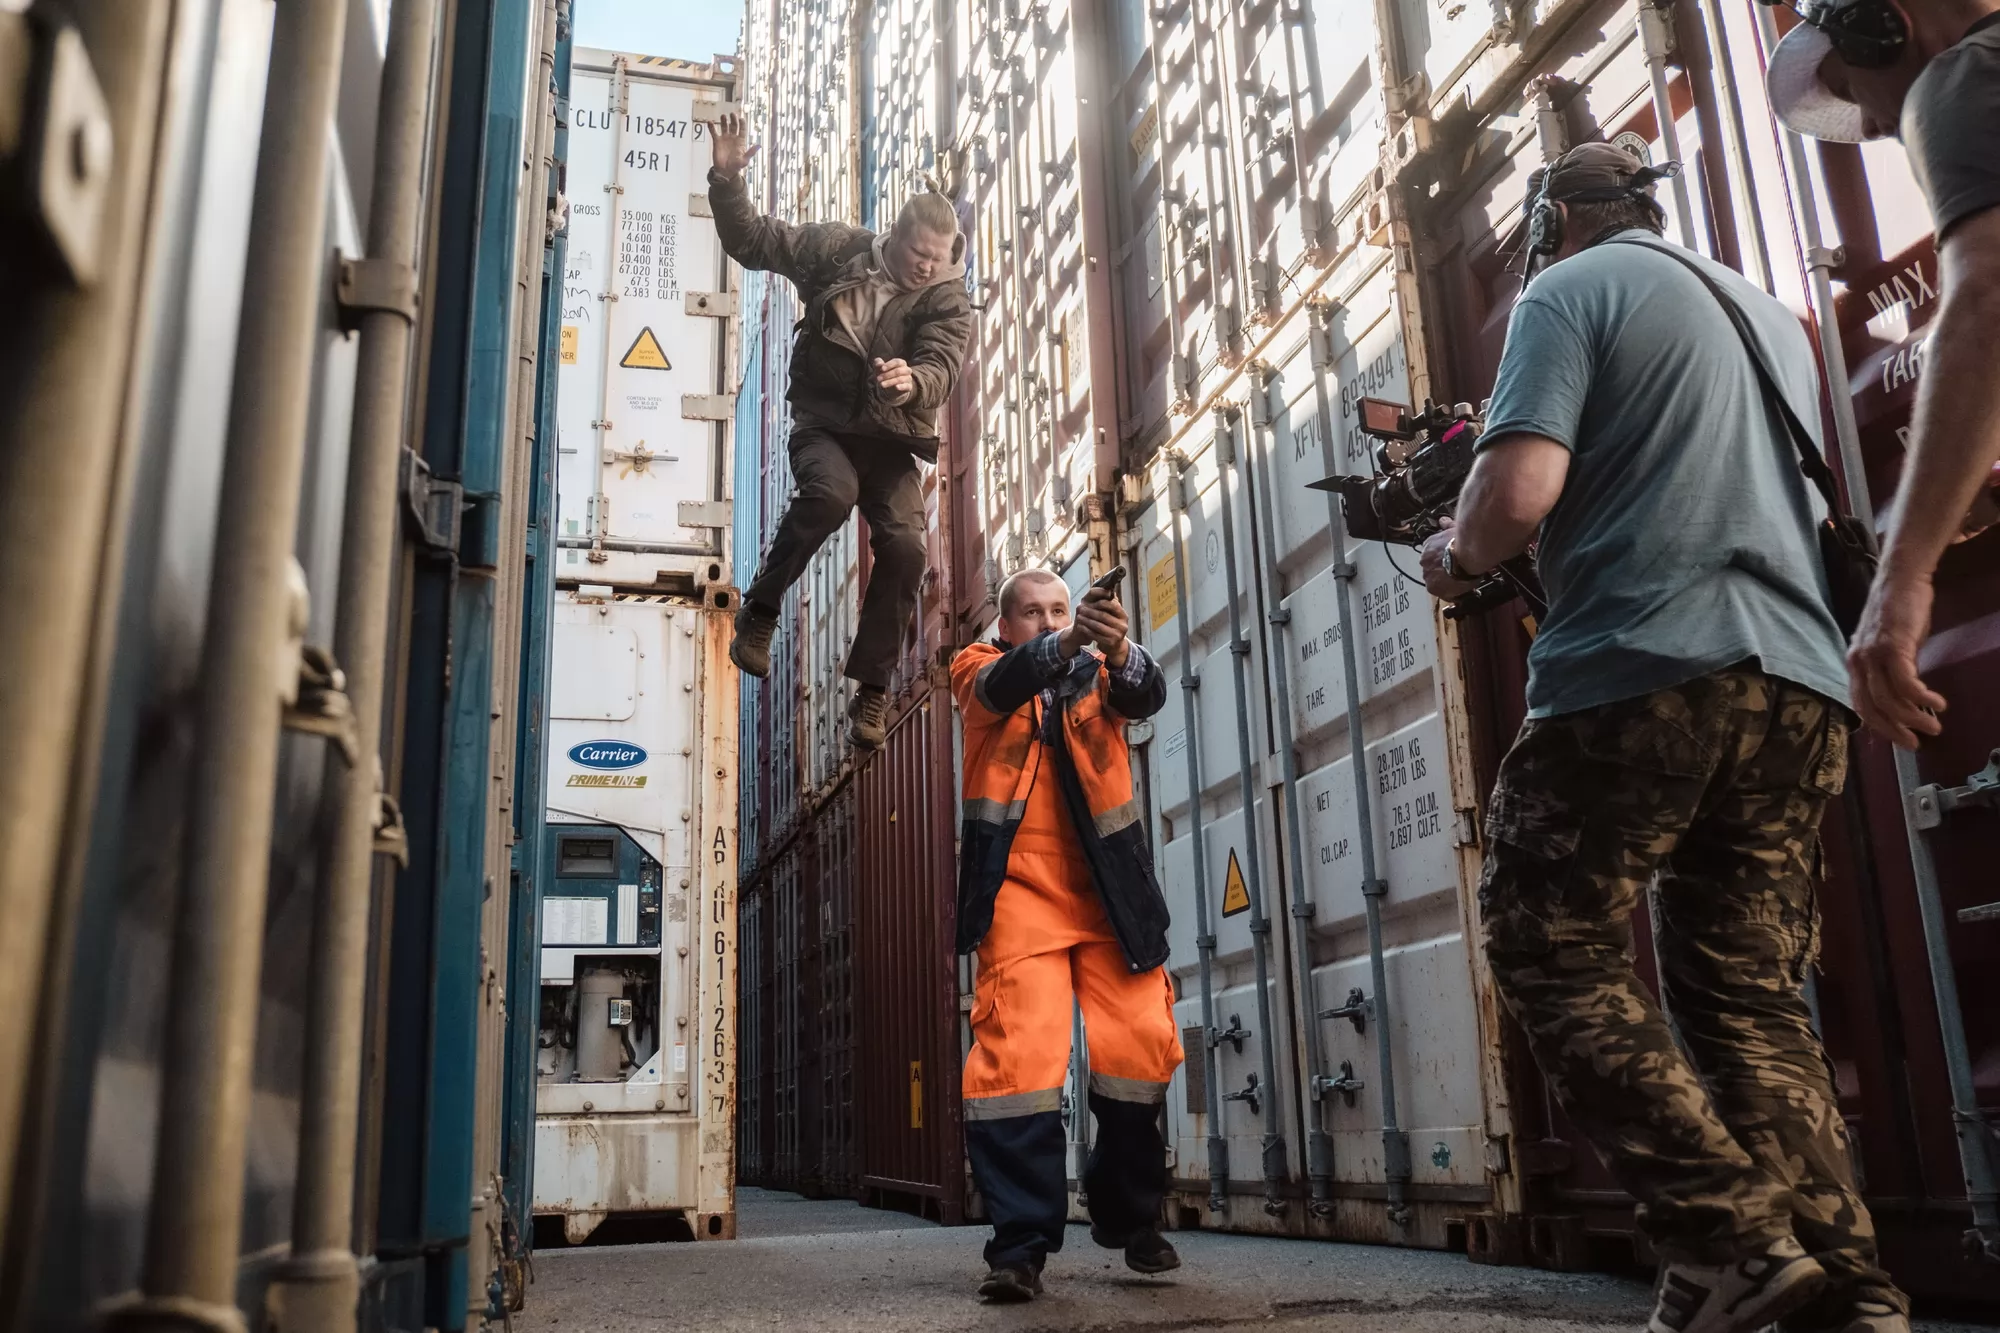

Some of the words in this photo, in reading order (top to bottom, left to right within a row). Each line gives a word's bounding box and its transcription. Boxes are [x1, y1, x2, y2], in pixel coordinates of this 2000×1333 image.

[570, 108, 611, 130] CLU
[625, 115, 687, 139] 118547
[694, 123, 703, 140] 9
[624, 150, 670, 172] 45R1
[573, 204, 601, 216] GROSS
[621, 210, 653, 222] 35.000
[621, 221, 653, 233] 77.160
[626, 232, 652, 244] 4.600
[619, 253, 651, 265] 30.400
[620, 242, 652, 254] 10.140
[618, 265, 651, 277] 67.020
[630, 276, 650, 287] 67.5
[623, 286, 650, 299] 2.383
[1341, 346, 1395, 419] 893494
[1362, 582, 1390, 613] 32.500
[1393, 573, 1405, 594] KG
[1364, 605, 1391, 634] 71.650
[1394, 592, 1410, 617] LBS
[1301, 636, 1321, 662] MAX.
[1371, 635, 1394, 664] 3.800
[1398, 628, 1410, 649] KG
[1400, 647, 1415, 672] LBS
[1306, 686, 1325, 712] TARE
[579, 746, 638, 762] Carrier
[1377, 745, 1405, 775] 28.700
[1408, 737, 1421, 759] KG
[567, 775, 640, 786] PRIMELINE
[1379, 766, 1407, 795] 63.270
[1411, 757, 1427, 782] LBS
[1316, 790, 1331, 813] NET
[1392, 802, 1411, 827] 76.3
[1415, 791, 1439, 817] CU.M.
[1389, 825, 1412, 851] 2.697
[1417, 812, 1442, 839] CU.FT.
[1320, 836, 1352, 866] CU.CAP.
[713, 931, 725, 1085] 611263
[713, 1096, 725, 1113] 7
